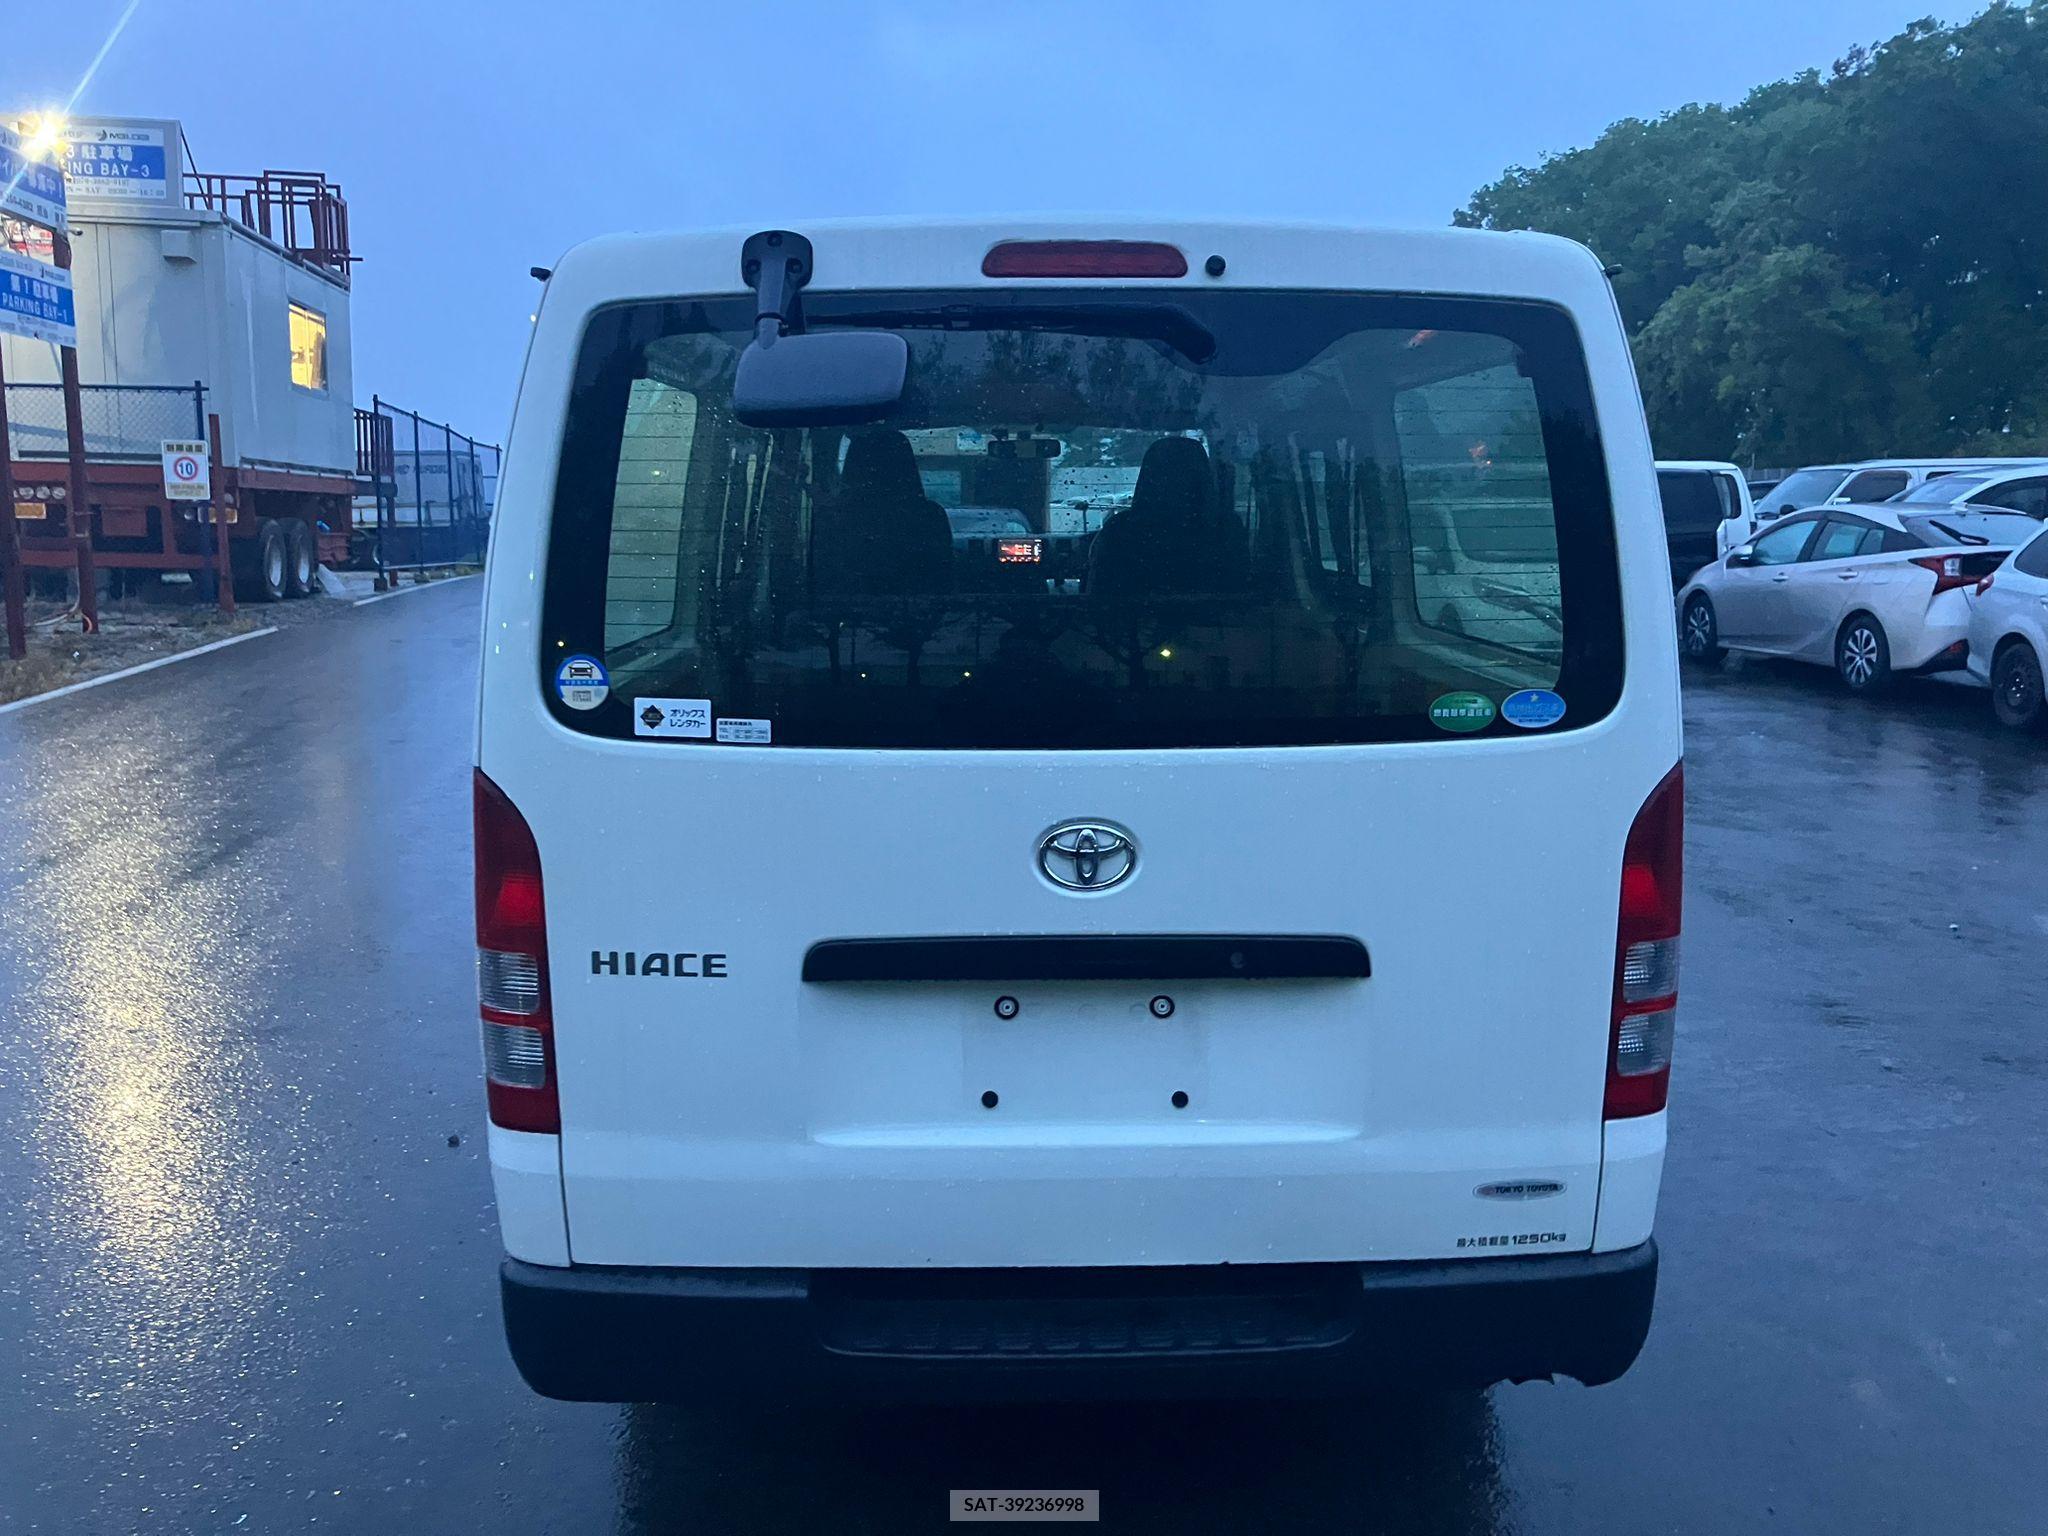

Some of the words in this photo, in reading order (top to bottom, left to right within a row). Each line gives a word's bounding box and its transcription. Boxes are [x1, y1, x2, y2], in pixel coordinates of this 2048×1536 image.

[66, 144, 133, 161] 3駐車場
[101, 163, 150, 177] BAY-3
[2, 291, 40, 316] PARKING
[43, 302, 67, 323] BAY-1
[179, 462, 193, 476] 10
[669, 709, 706, 719] オリックス
[669, 719, 707, 728] レンタカー
[591, 951, 728, 978] HIACE
[1494, 1185, 1524, 1194] TOKYO
[1526, 1183, 1559, 1193] TOYOTA
[1511, 1232, 1567, 1246] 1250kg
